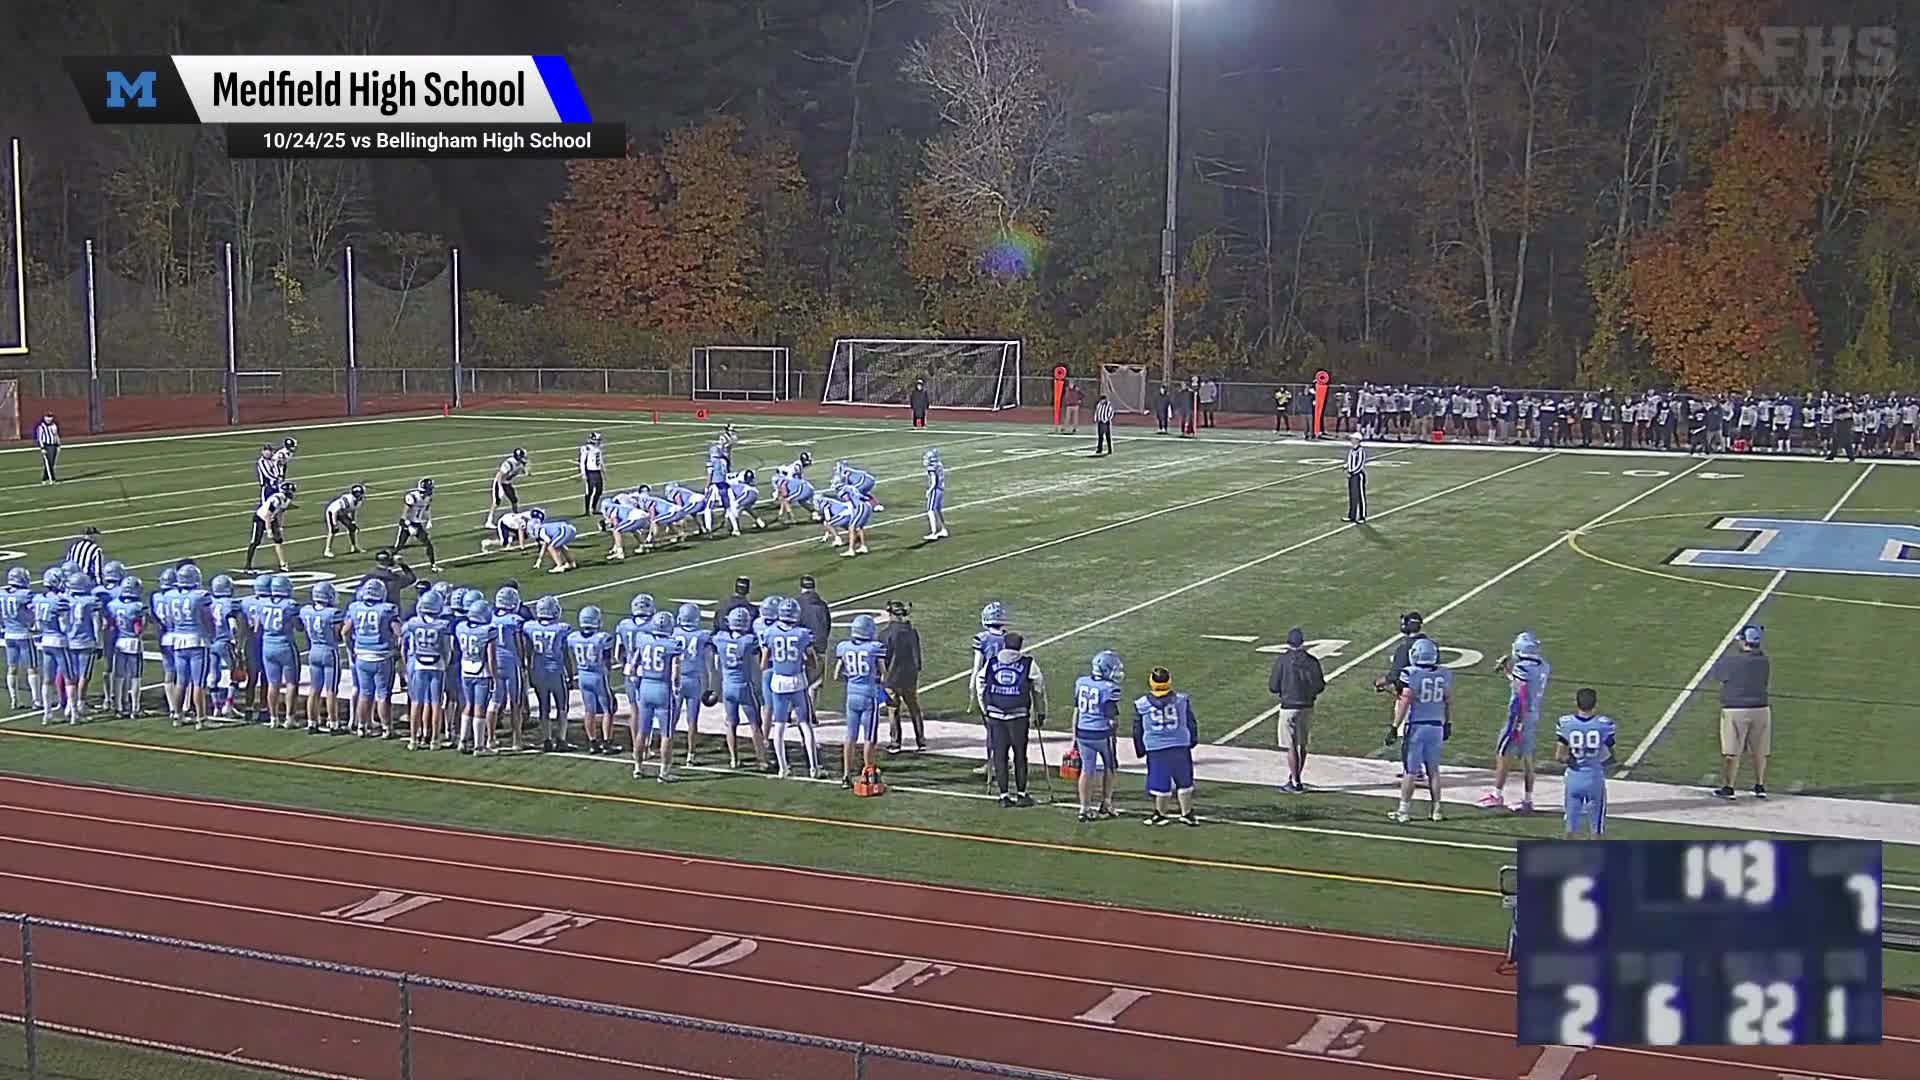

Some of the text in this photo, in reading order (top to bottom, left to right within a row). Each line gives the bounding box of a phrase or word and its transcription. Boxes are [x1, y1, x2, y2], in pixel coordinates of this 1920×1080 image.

[263, 606, 283, 631] 72
[356, 610, 379, 634] 79
[574, 643, 597, 665] 84
[642, 644, 665, 671] 46
[773, 636, 799, 661] 85
[845, 650, 870, 677] 86
[1078, 685, 1100, 713] 62
[1420, 677, 1444, 703] 66
[1149, 703, 1178, 731] 99
